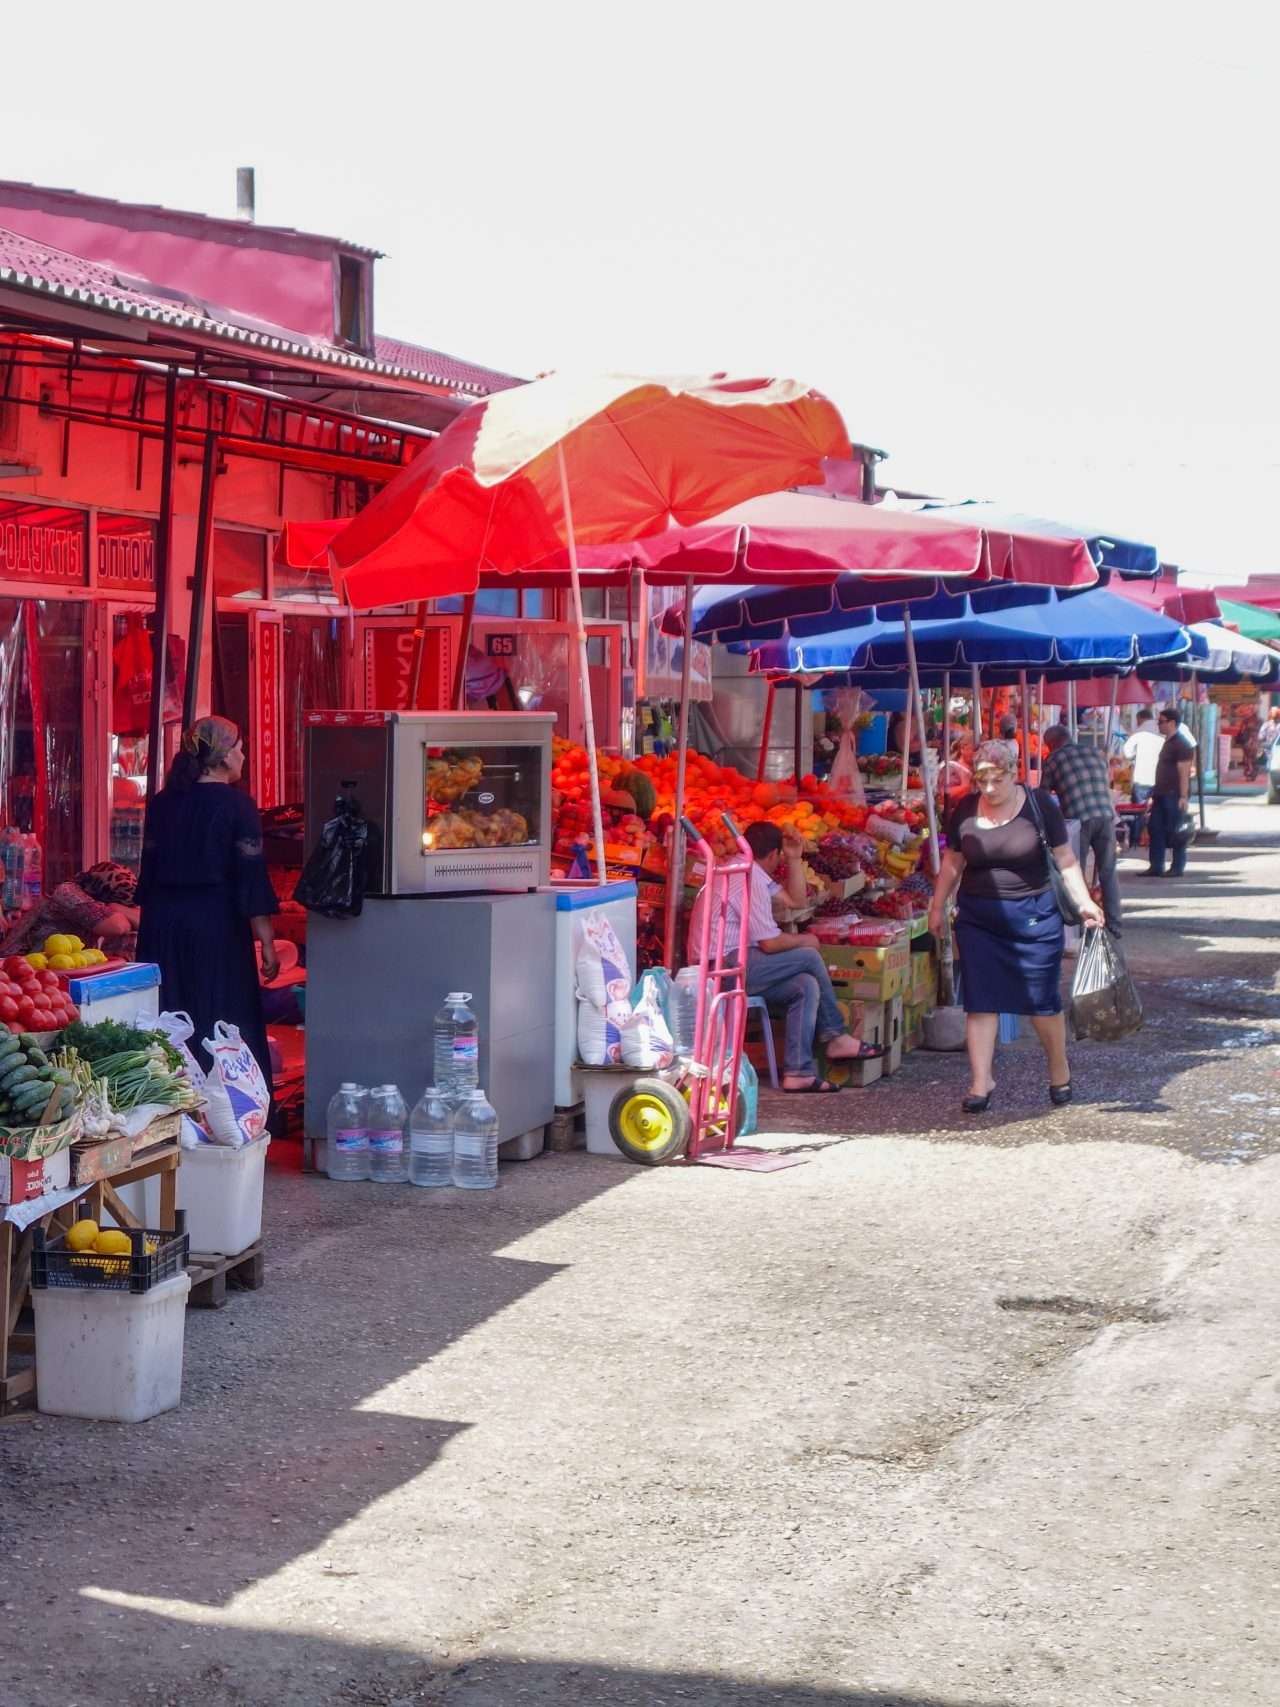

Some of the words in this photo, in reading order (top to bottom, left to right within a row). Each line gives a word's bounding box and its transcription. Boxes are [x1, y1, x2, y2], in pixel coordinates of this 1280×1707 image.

[97, 534, 155, 583] ОПТОМ
[491, 637, 513, 654] 65
[261, 629, 272, 809] СУХОФРУ
